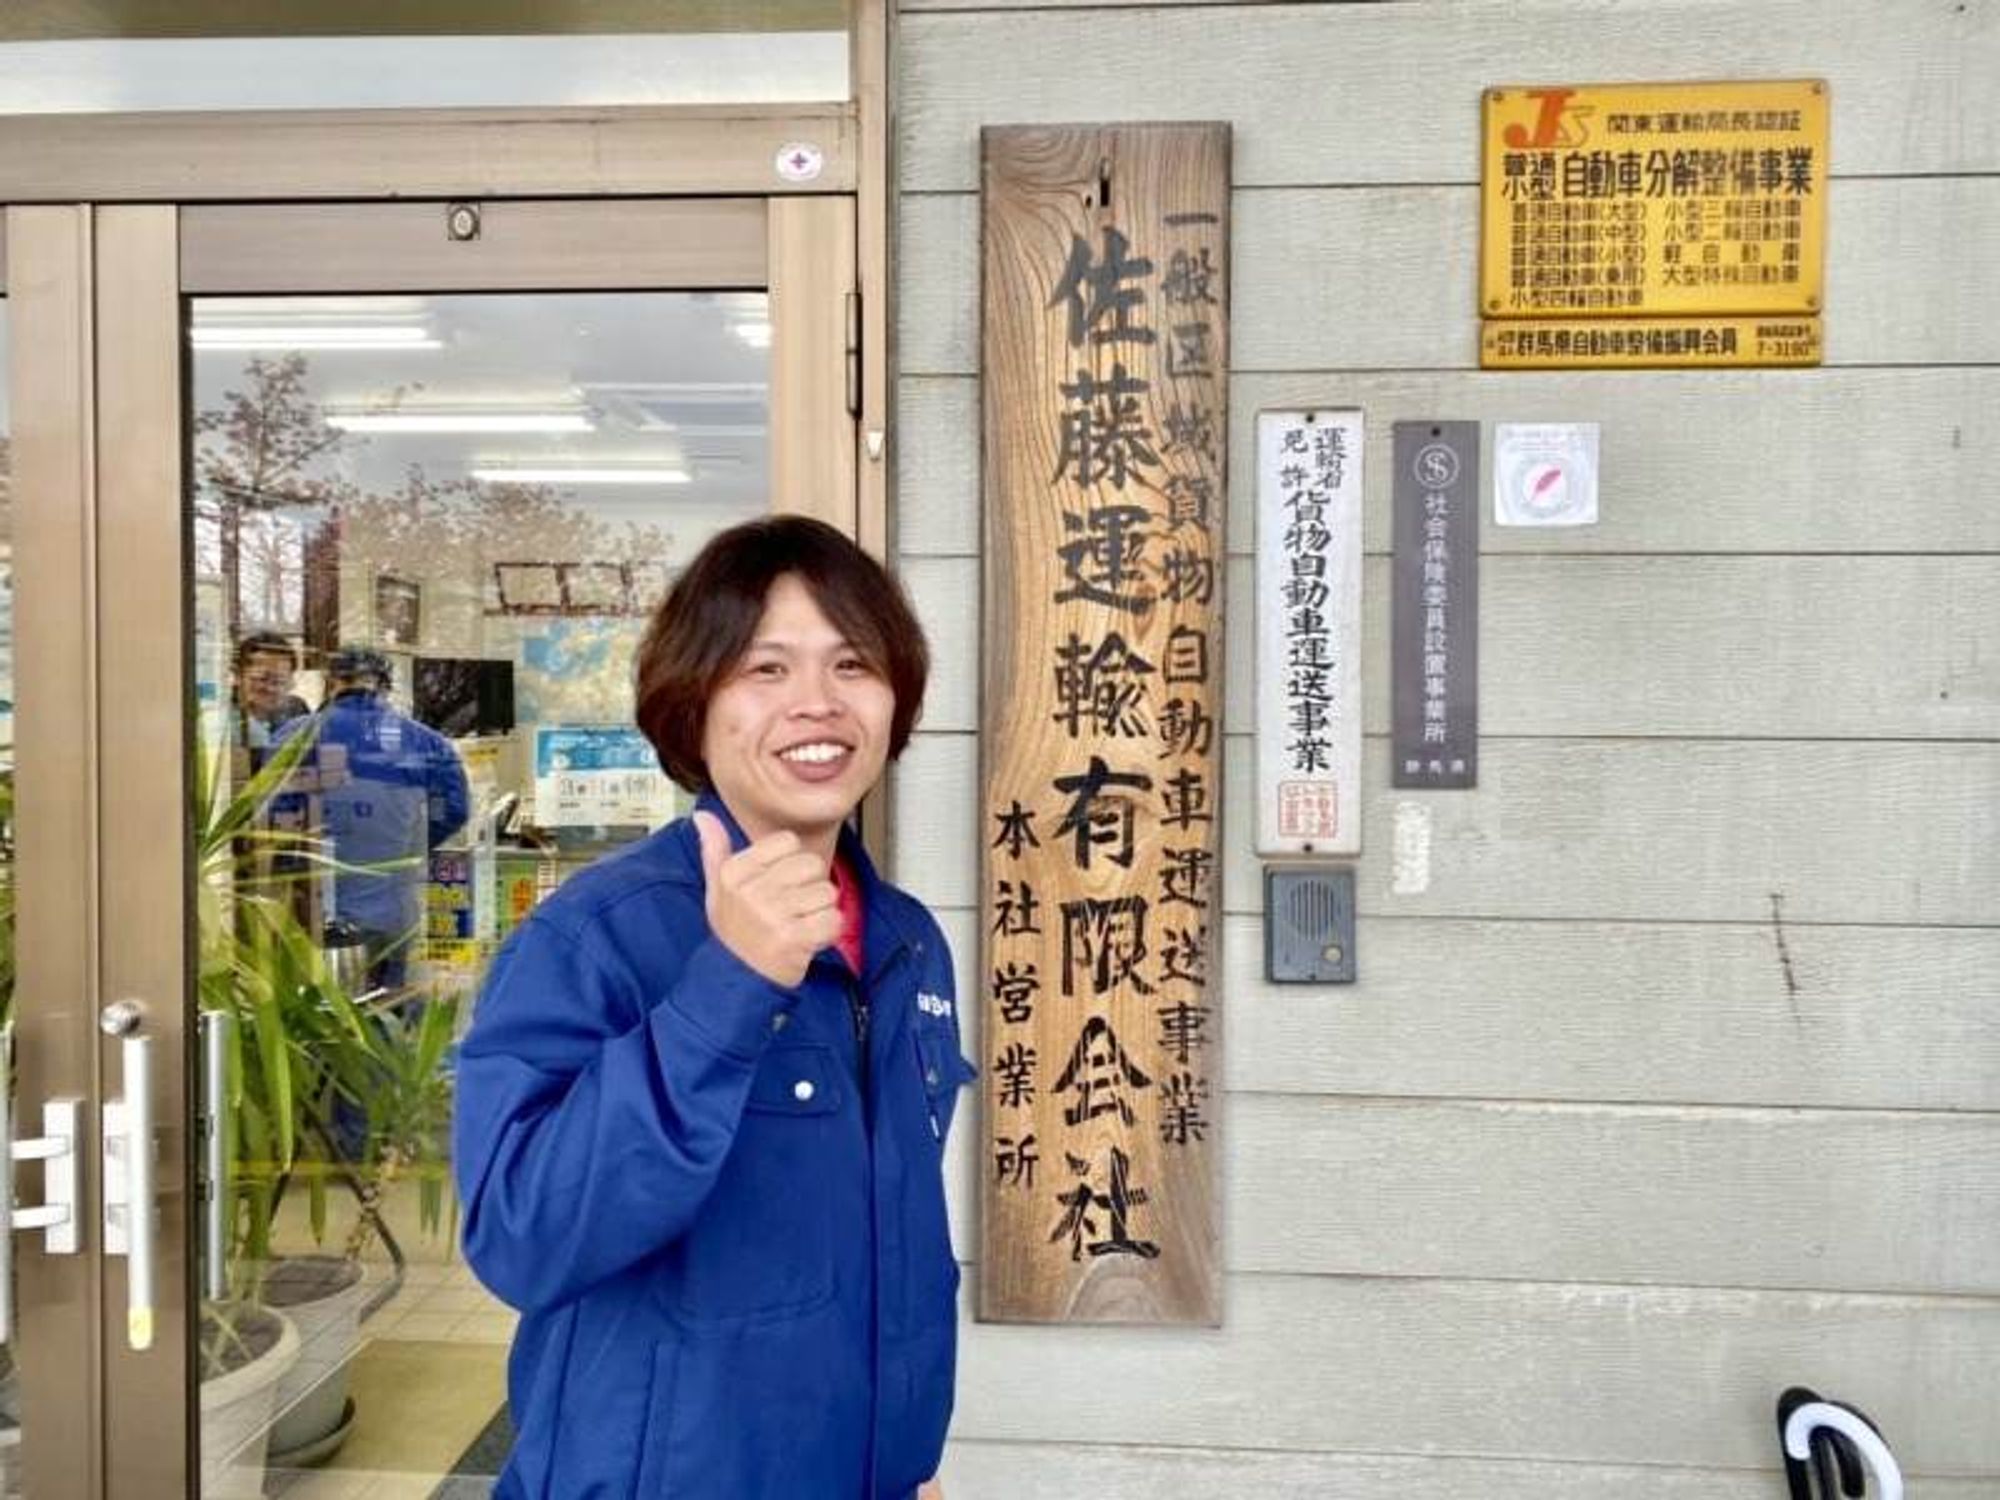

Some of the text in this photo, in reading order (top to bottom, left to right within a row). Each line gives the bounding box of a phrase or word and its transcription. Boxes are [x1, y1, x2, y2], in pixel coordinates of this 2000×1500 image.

[1562, 147, 1813, 199] 自動車分解整備事業
[1606, 110, 1801, 135] 関東運輸局長認証
[1048, 225, 1160, 1262] 佐藤運輸有限会社
[1281, 489, 1335, 774] 貨物自動車運送事業
[992, 799, 1041, 1188] 本社営業所
